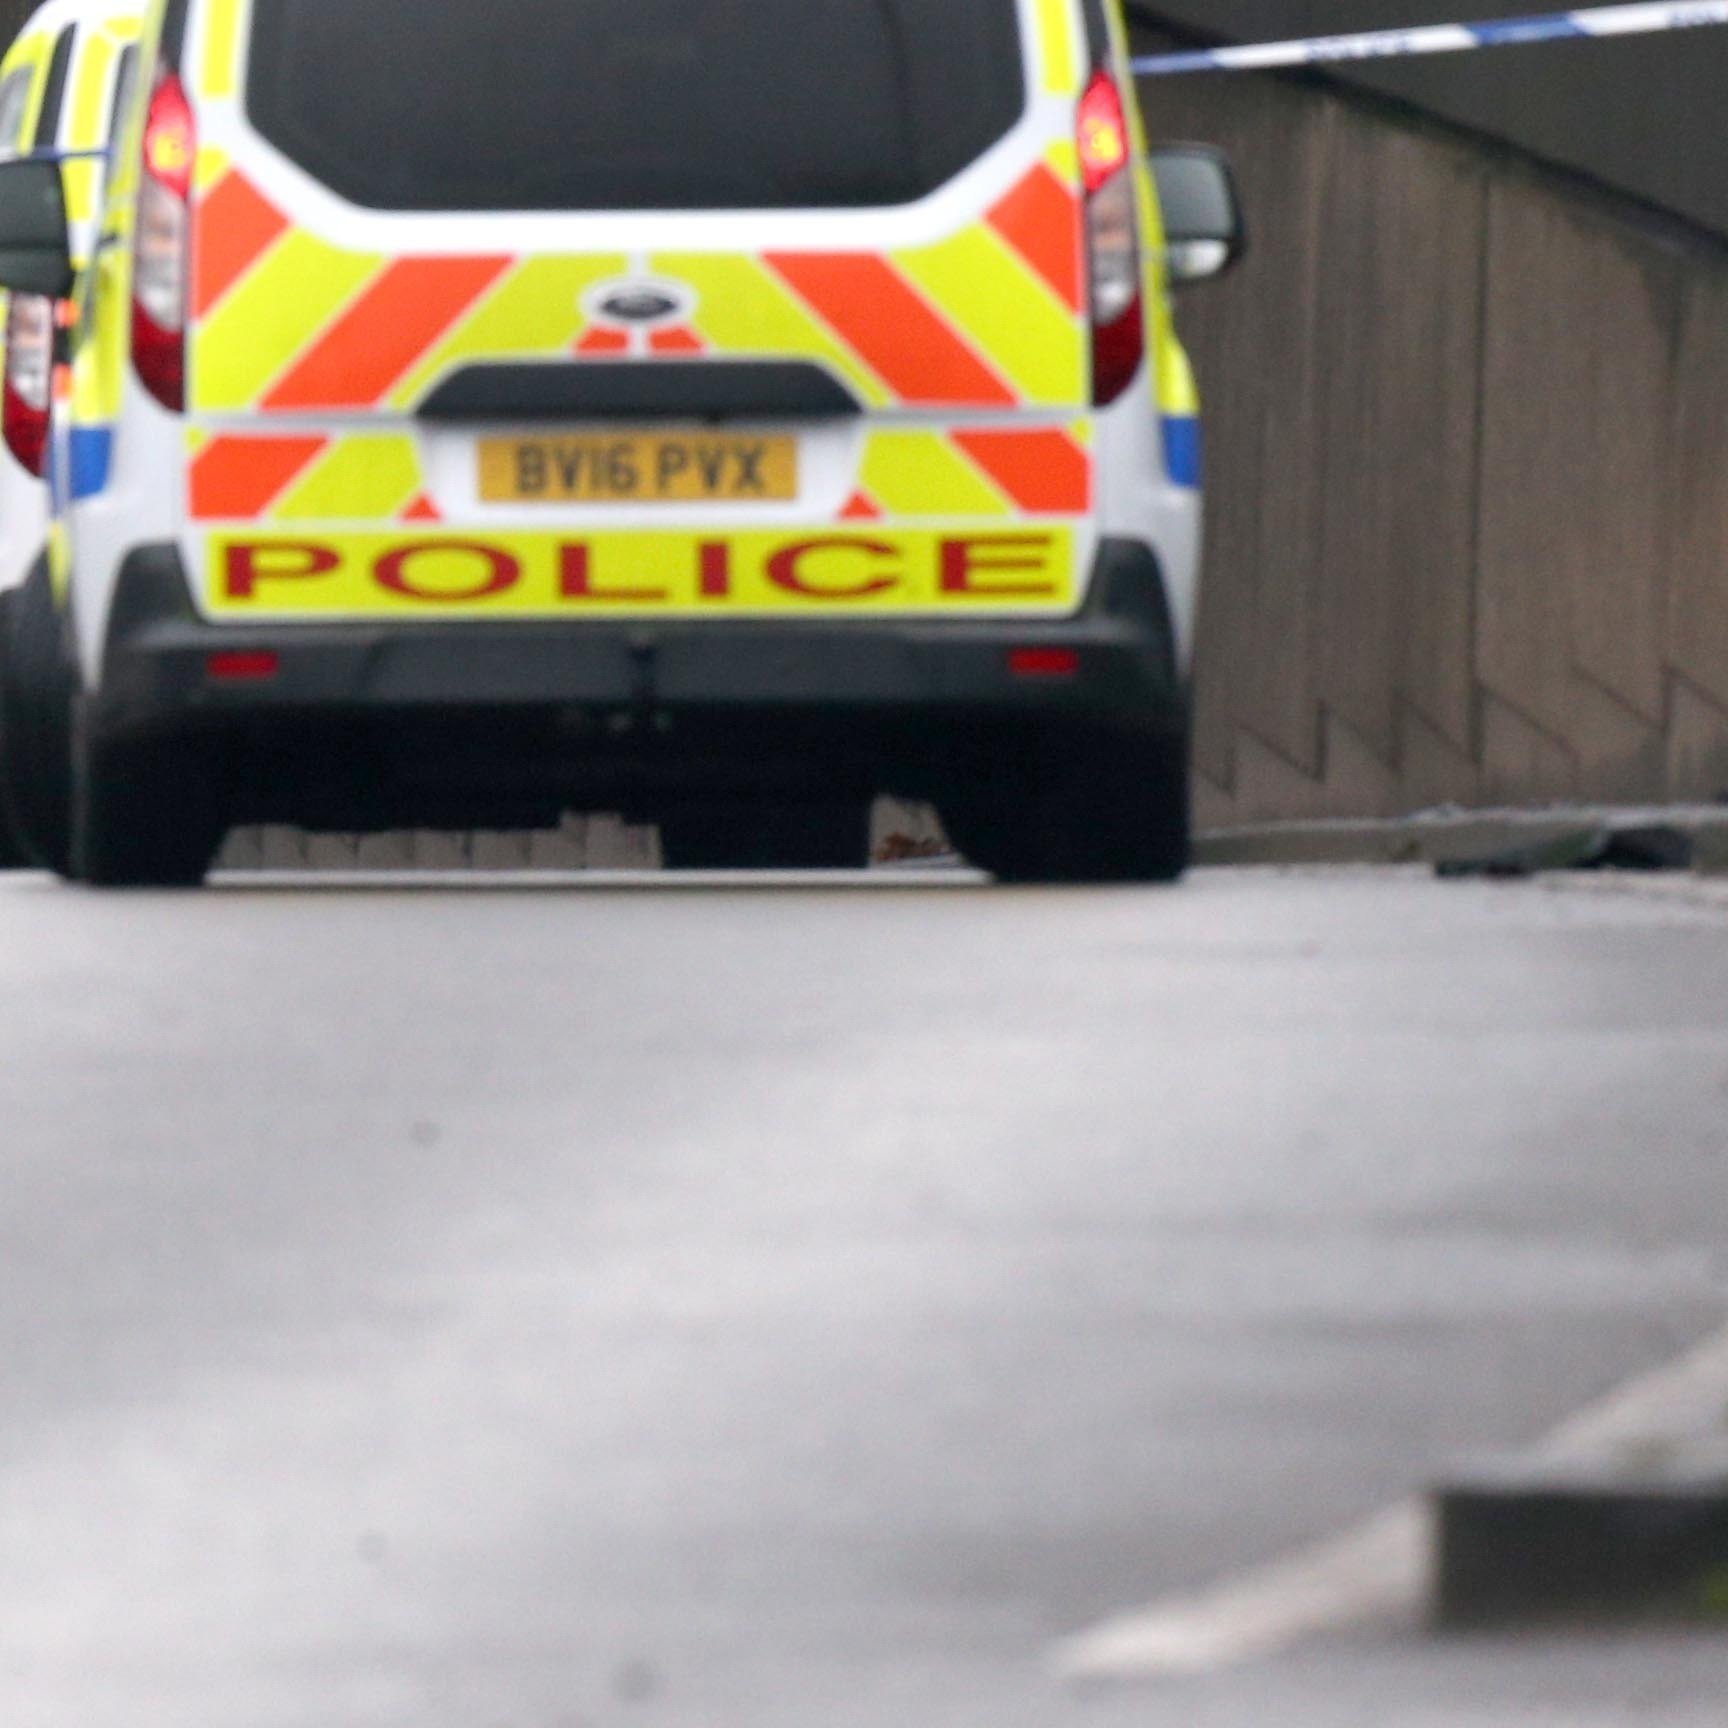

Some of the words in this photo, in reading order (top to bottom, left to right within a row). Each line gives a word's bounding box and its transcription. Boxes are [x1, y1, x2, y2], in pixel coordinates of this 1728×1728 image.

[514, 445, 638, 494] BV16
[654, 445, 769, 494] PVX
[223, 533, 1056, 602] POLICE
